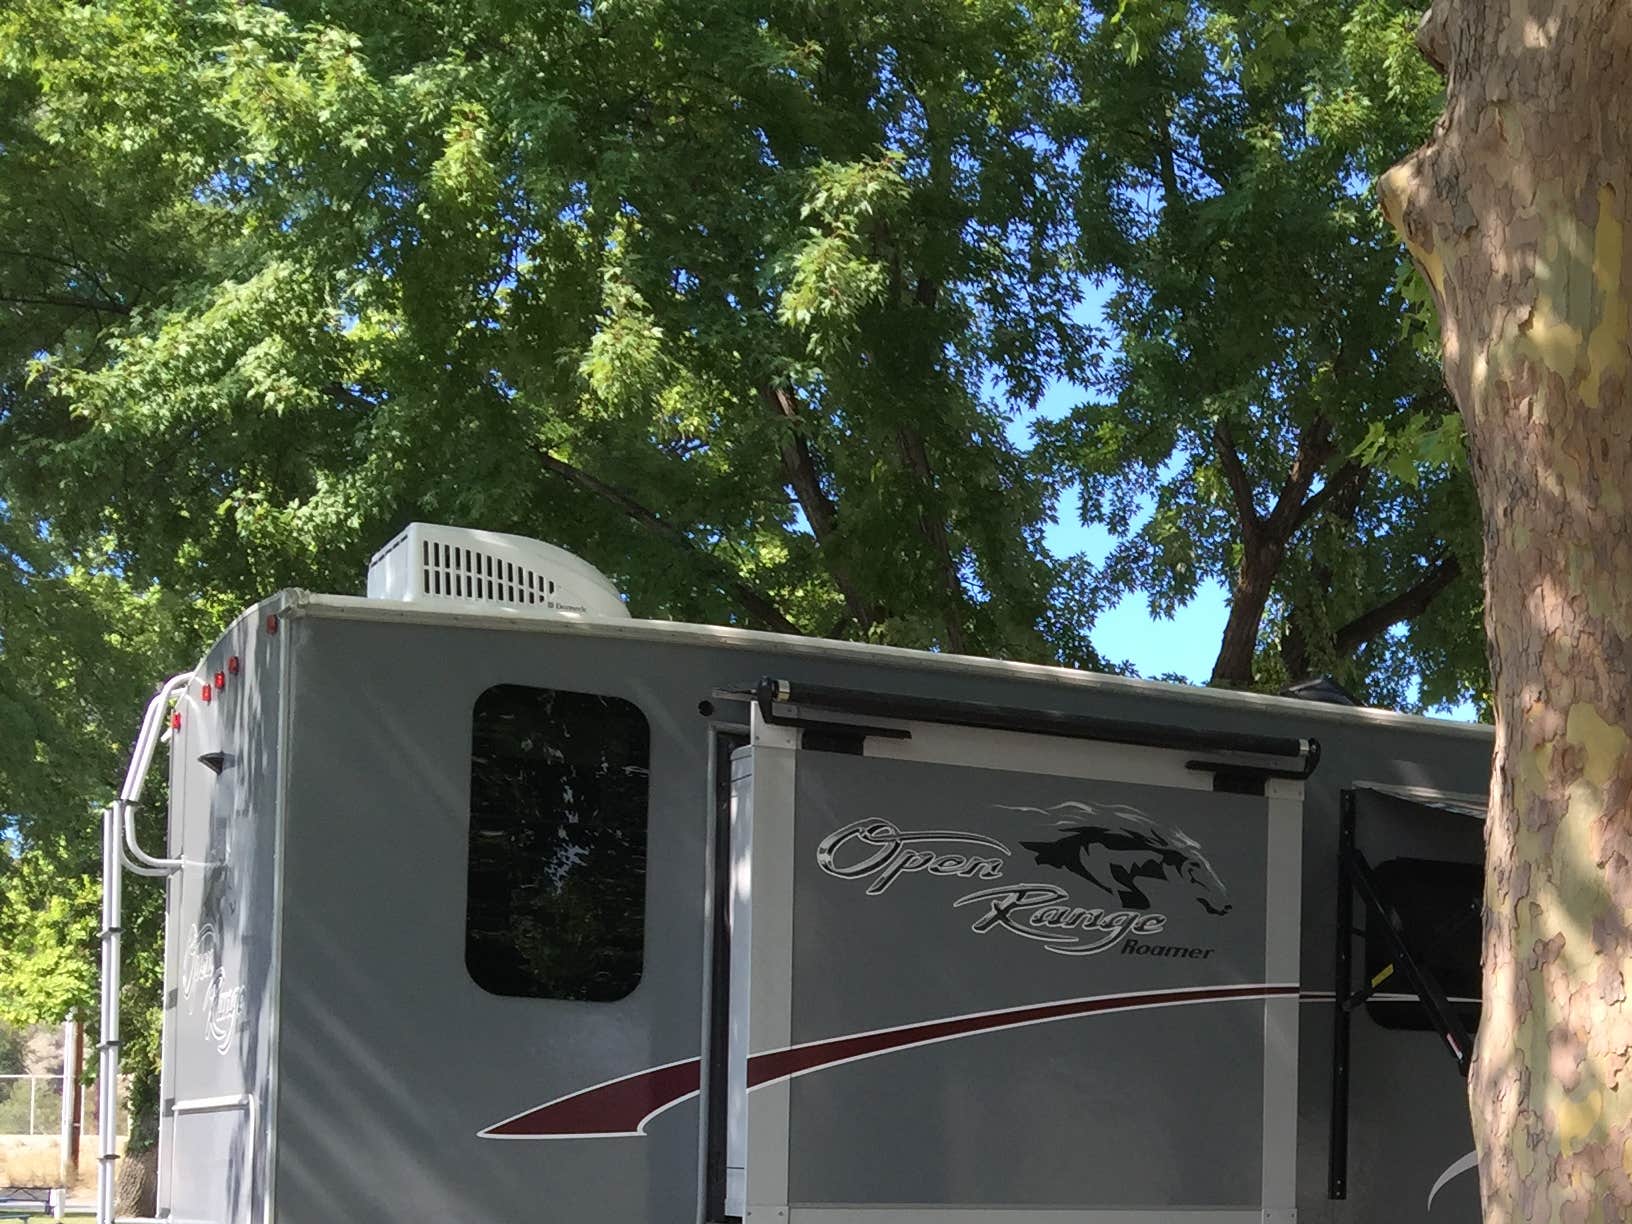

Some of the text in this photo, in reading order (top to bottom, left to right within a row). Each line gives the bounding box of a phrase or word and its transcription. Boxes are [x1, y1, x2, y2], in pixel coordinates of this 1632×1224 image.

[817, 817, 1011, 895] Open
[953, 883, 1167, 955] Range
[1121, 938, 1215, 960] Roamer
